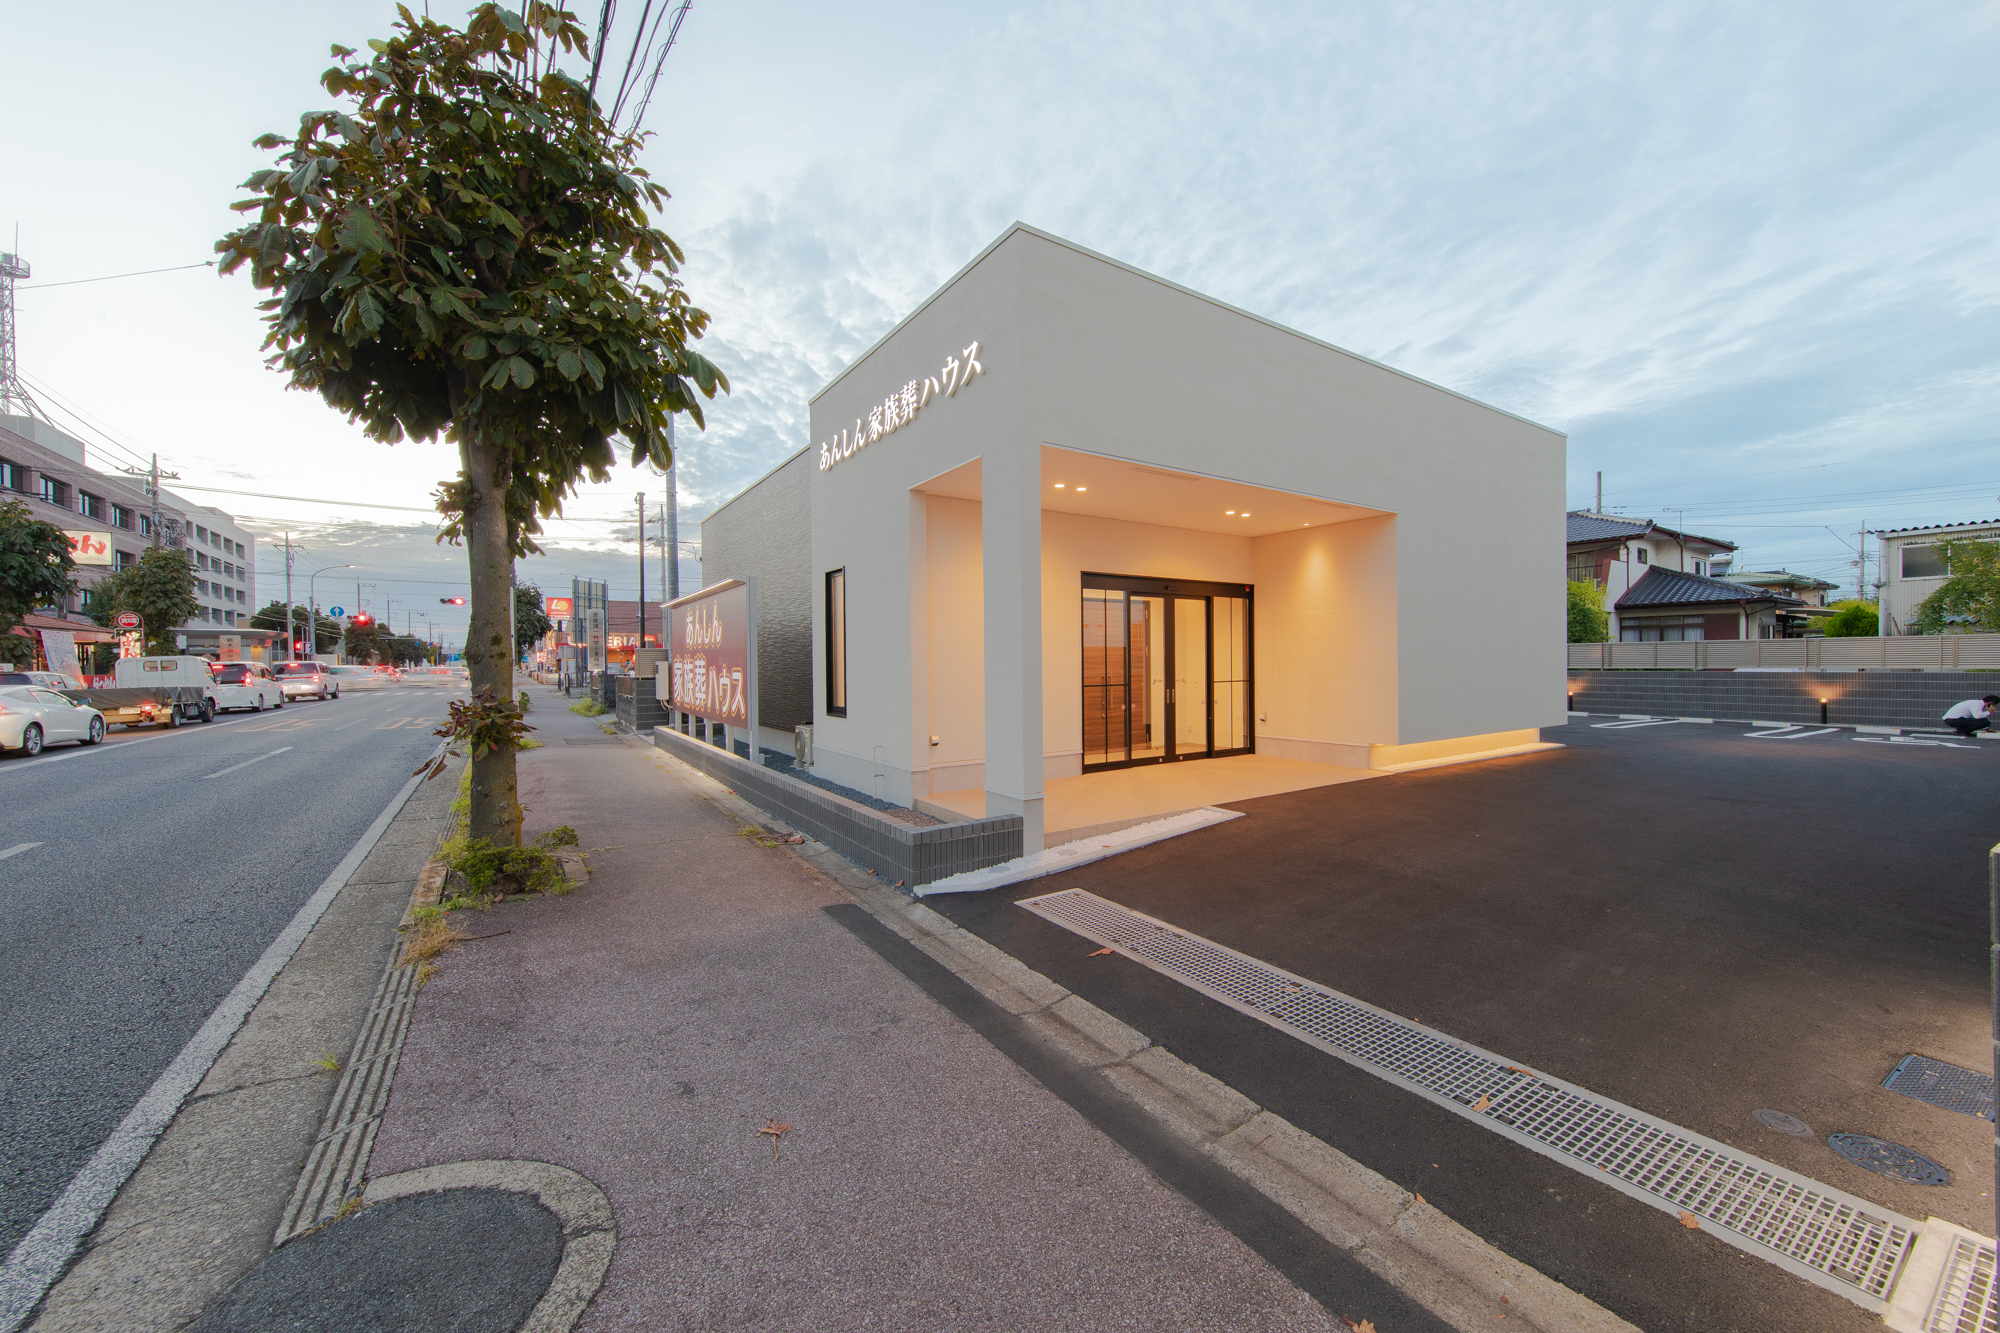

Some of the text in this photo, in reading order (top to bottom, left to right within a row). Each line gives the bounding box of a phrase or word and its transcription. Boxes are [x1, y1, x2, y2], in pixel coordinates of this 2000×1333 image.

[819, 339, 986, 472] あんしん家族葬ハウス
[685, 600, 723, 650] あんしん
[674, 652, 745, 719] 家族葬ハウス
